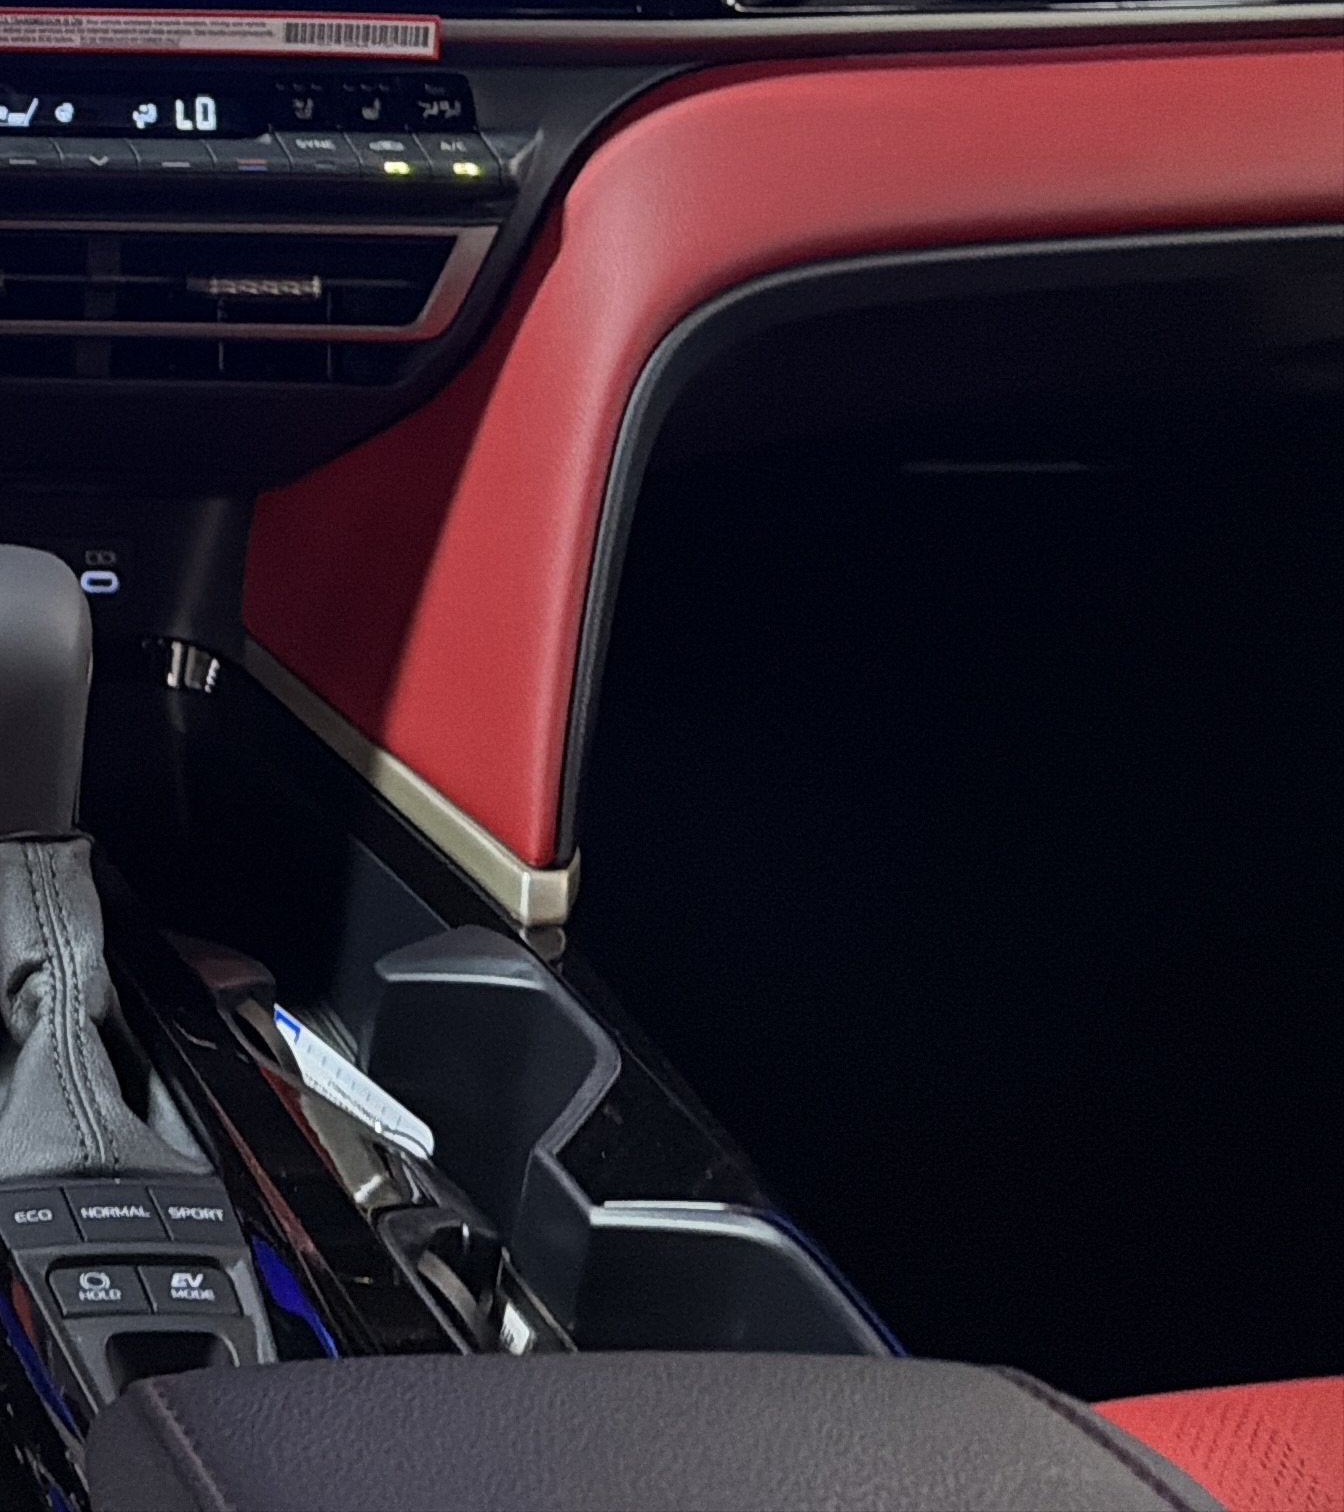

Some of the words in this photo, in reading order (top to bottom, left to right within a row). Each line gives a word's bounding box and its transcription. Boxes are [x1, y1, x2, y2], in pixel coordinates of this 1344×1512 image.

[14, 1208, 53, 1224] ECO
[80, 1205, 151, 1220] NORMAL
[168, 1205, 225, 1223] SPORT
[170, 1272, 206, 1289] EV
[78, 1289, 122, 1302] HOLD
[170, 1289, 216, 1302] MODE
